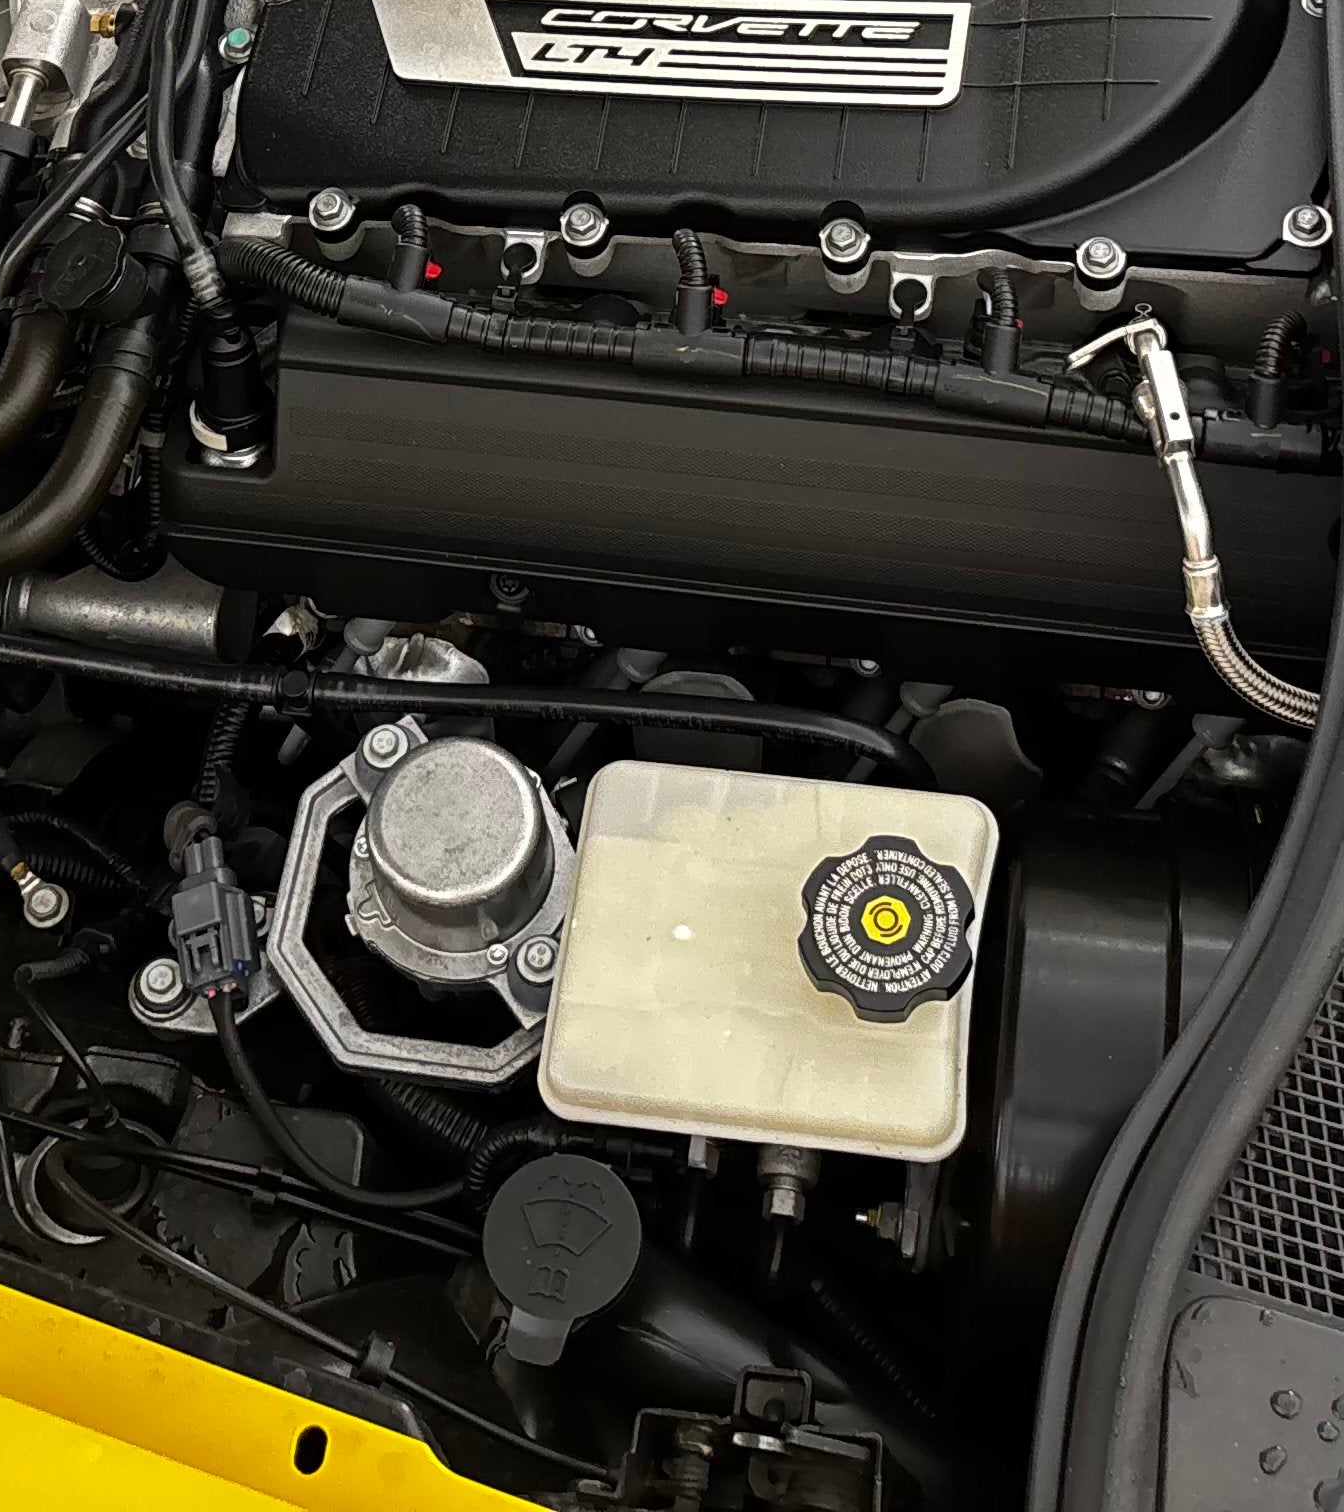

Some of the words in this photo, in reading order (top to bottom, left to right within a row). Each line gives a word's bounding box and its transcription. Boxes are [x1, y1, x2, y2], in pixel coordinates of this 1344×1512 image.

[541, 9, 922, 41] CORVETTE
[531, 44, 654, 66] LT4
[873, 861, 898, 871] ONLY
[898, 862, 918, 878] USE
[825, 870, 841, 886] LA
[830, 876, 852, 902] FREIN
[876, 873, 911, 888] FILLER
[923, 862, 951, 894] SEALED
[814, 884, 832, 913] AVANT
[826, 900, 838, 913] DE
[907, 881, 931, 910] CLEAN
[943, 891, 954, 900] A
[838, 903, 850, 934] BIDON
[945, 898, 958, 926] FROM
[813, 914, 831, 957] BOUCHON
[826, 915, 842, 950] LIQUIDE
[930, 915, 946, 950] BEFORE
[943, 926, 958, 951] FLUID
[824, 953, 839, 969] LE
[835, 948, 850, 964] DU
[846, 958, 867, 976] QUE
[858, 951, 914, 968] PROVENANT
[920, 946, 937, 965] CAP
[833, 964, 878, 992] NETTOYER
